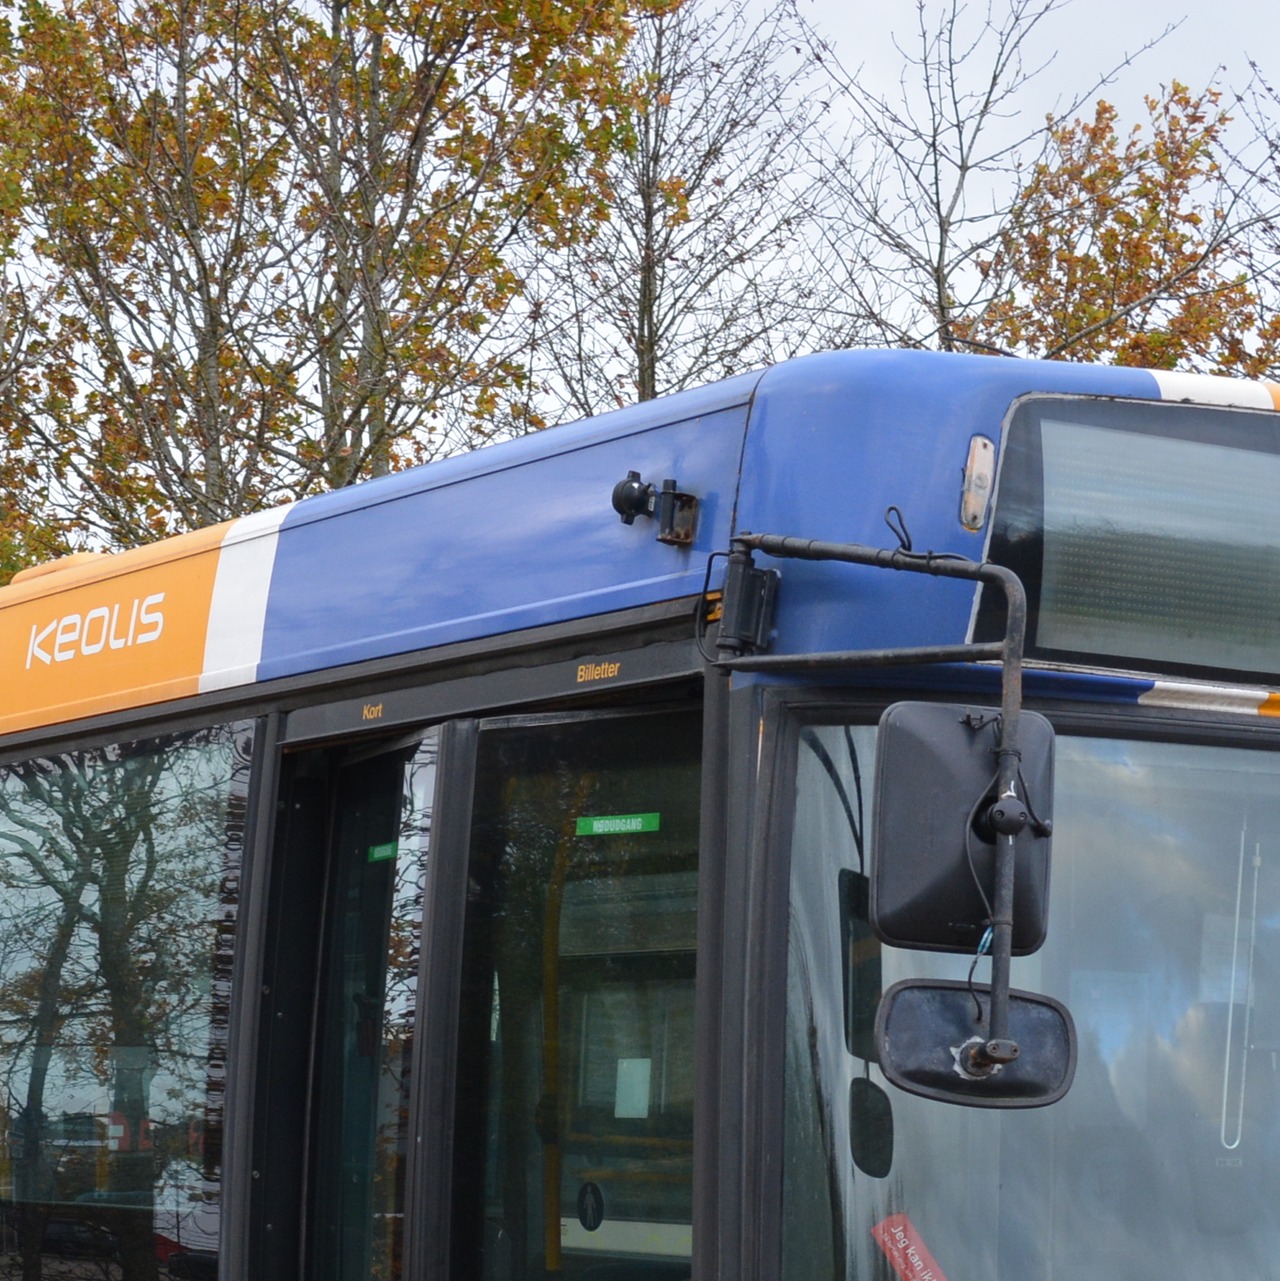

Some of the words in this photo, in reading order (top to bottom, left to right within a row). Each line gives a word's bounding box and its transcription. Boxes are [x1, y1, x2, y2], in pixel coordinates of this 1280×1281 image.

[25, 592, 166, 669] KEOLIS
[577, 662, 621, 682] Billetter
[362, 703, 383, 720] Kort
[593, 817, 643, 832] NØDUDGANG
[891, 1226, 909, 1248] Jeg
[905, 1246, 924, 1270] kan
